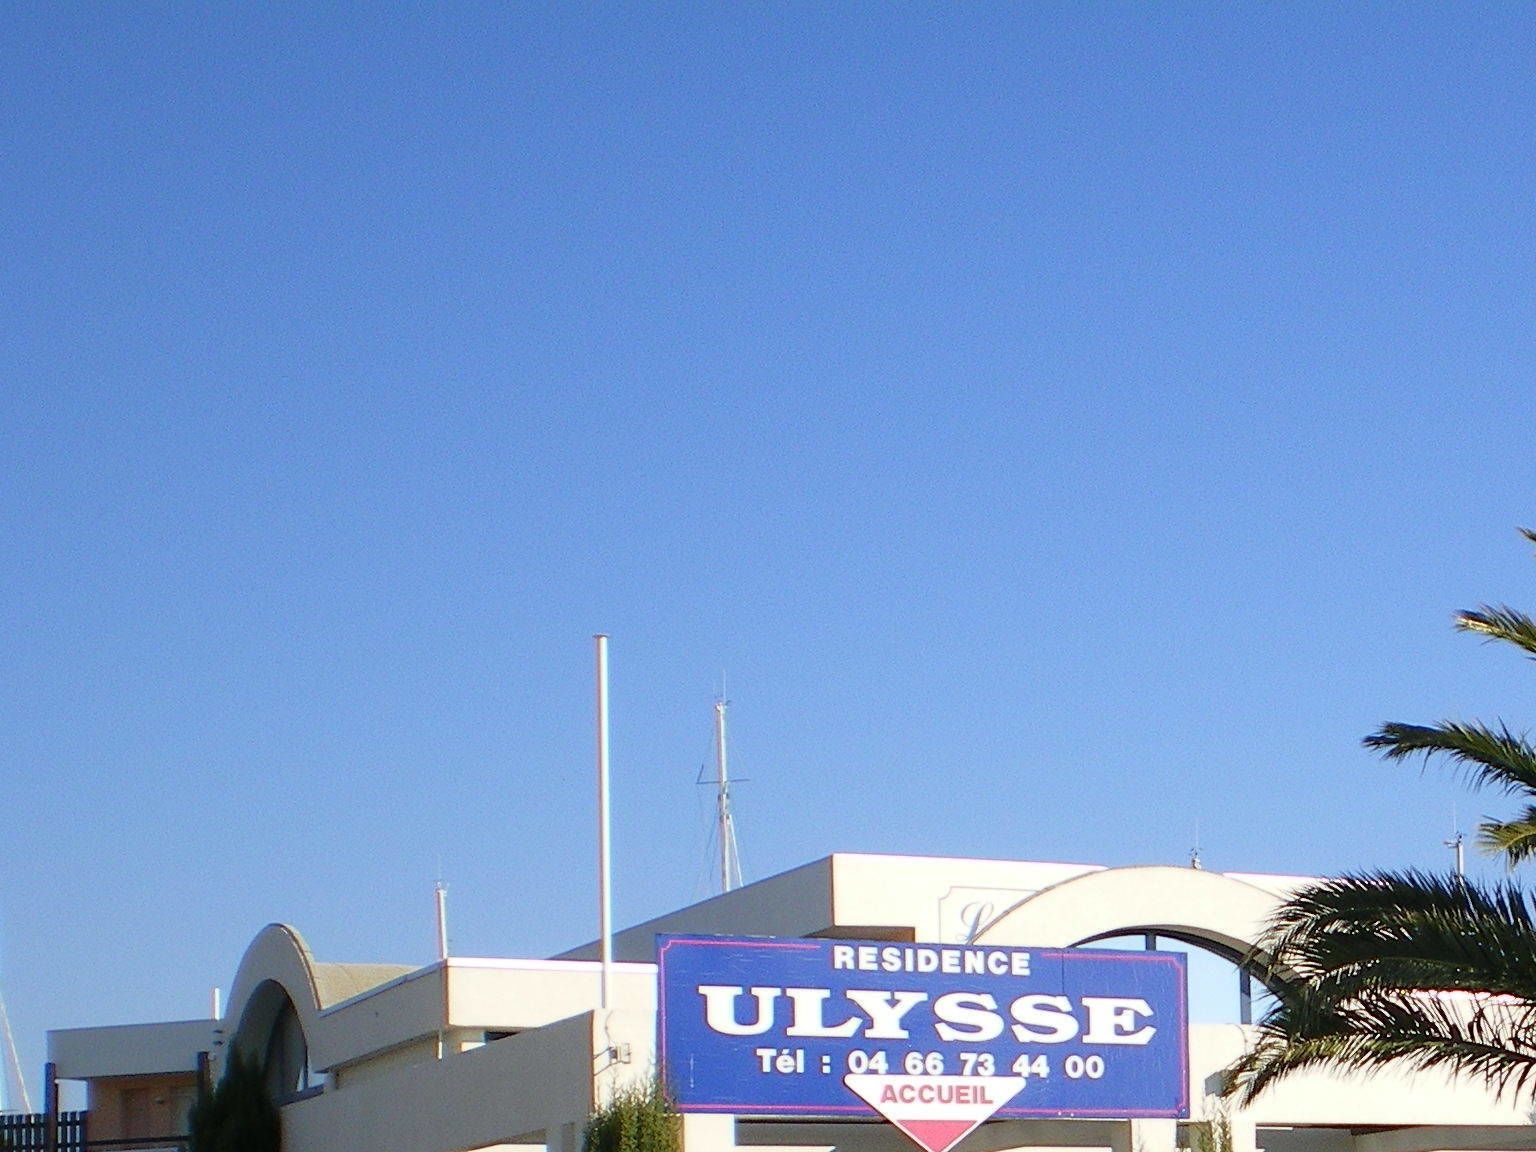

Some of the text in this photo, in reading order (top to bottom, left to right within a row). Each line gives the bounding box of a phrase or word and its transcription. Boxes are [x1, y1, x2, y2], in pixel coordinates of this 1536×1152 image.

[834, 945, 1031, 976] RESIDENCE
[698, 985, 1157, 1045] ULYSSE
[756, 1048, 805, 1074] Tél
[848, 1050, 888, 1075] 04
[904, 1051, 944, 1076] 66
[960, 1052, 996, 1076] 73
[1012, 1054, 1050, 1078] 44
[1065, 1055, 1105, 1079] 00
[880, 1084, 994, 1104] ACCUEIL
